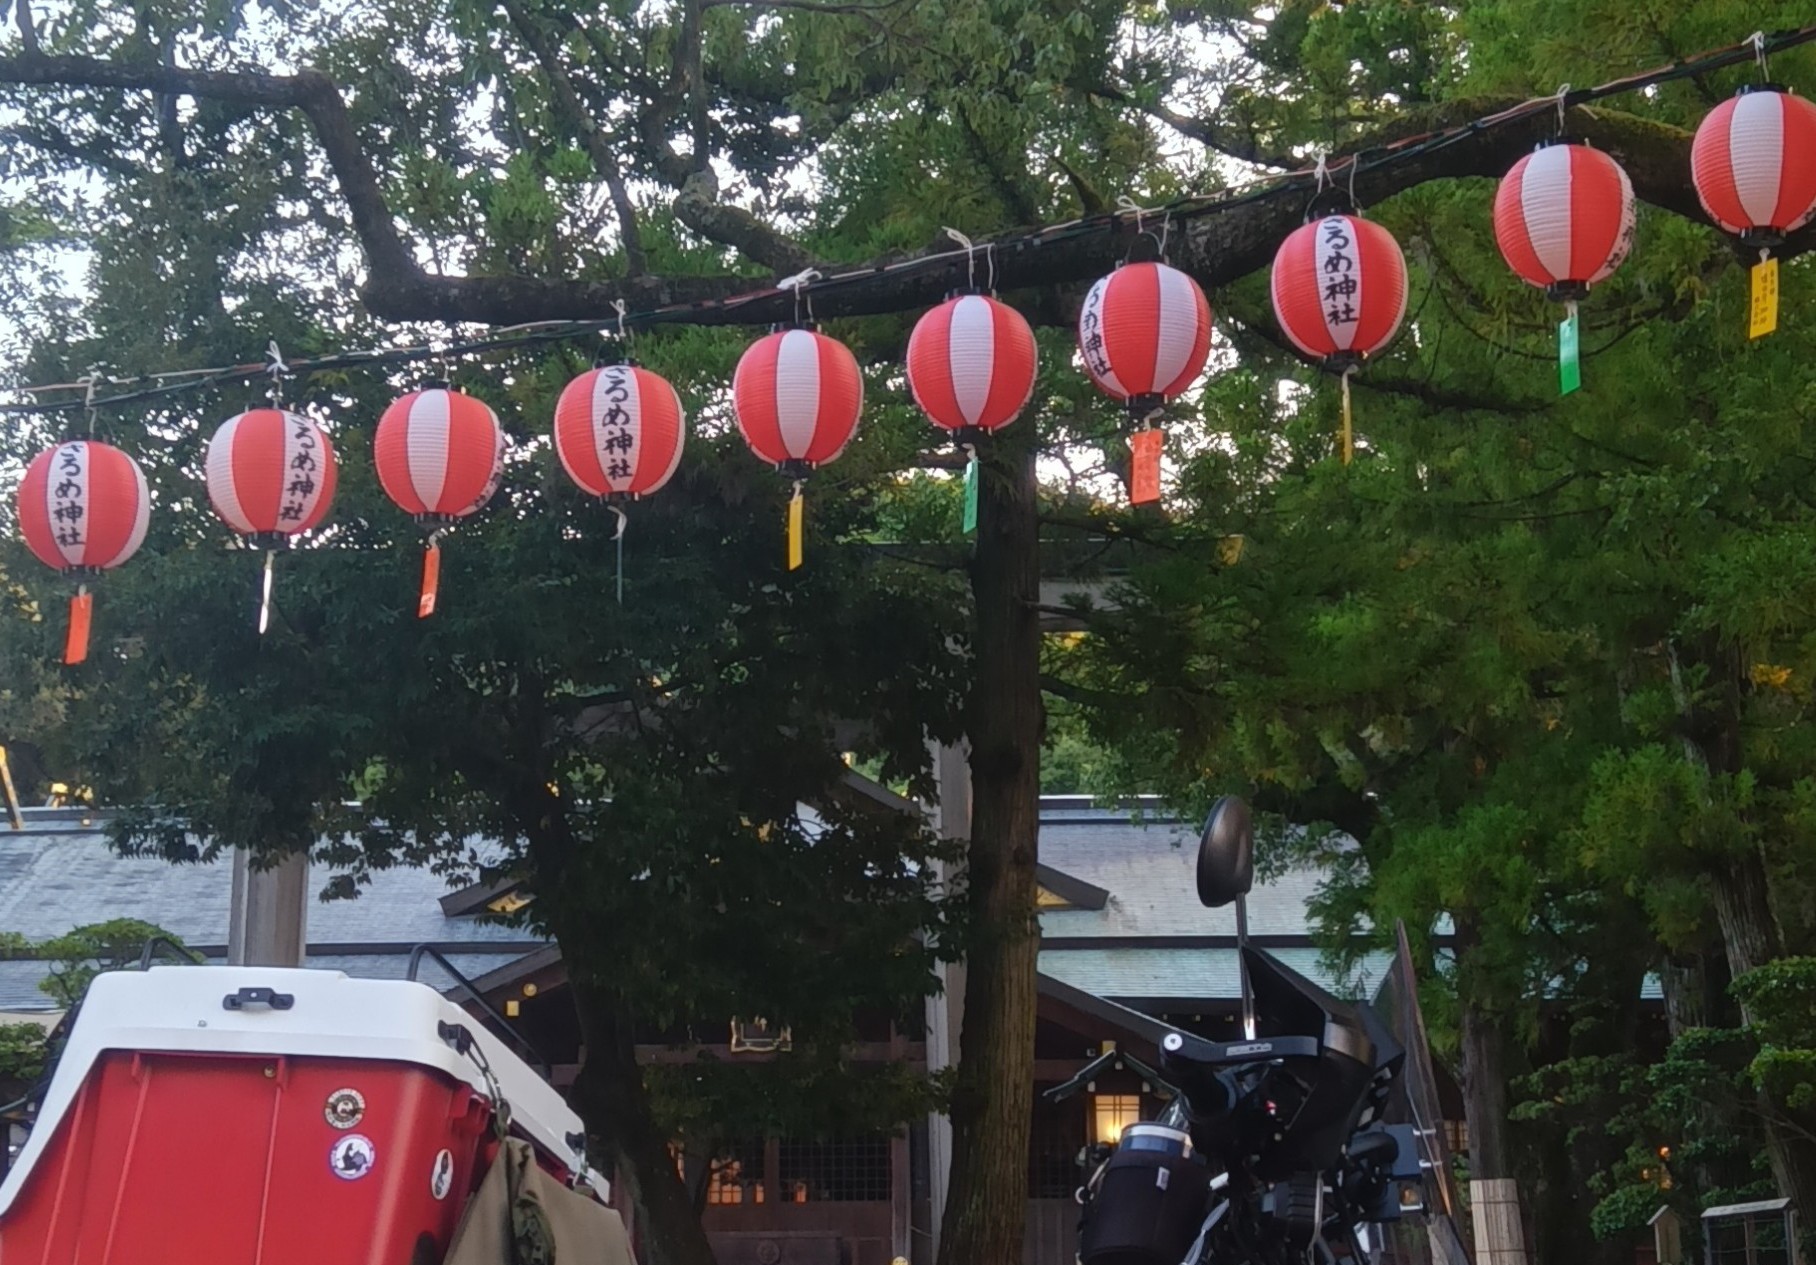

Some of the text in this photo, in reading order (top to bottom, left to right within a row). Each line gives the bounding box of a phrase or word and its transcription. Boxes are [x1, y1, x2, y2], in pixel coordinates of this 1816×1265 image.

[601, 367, 633, 480] さるめ神社
